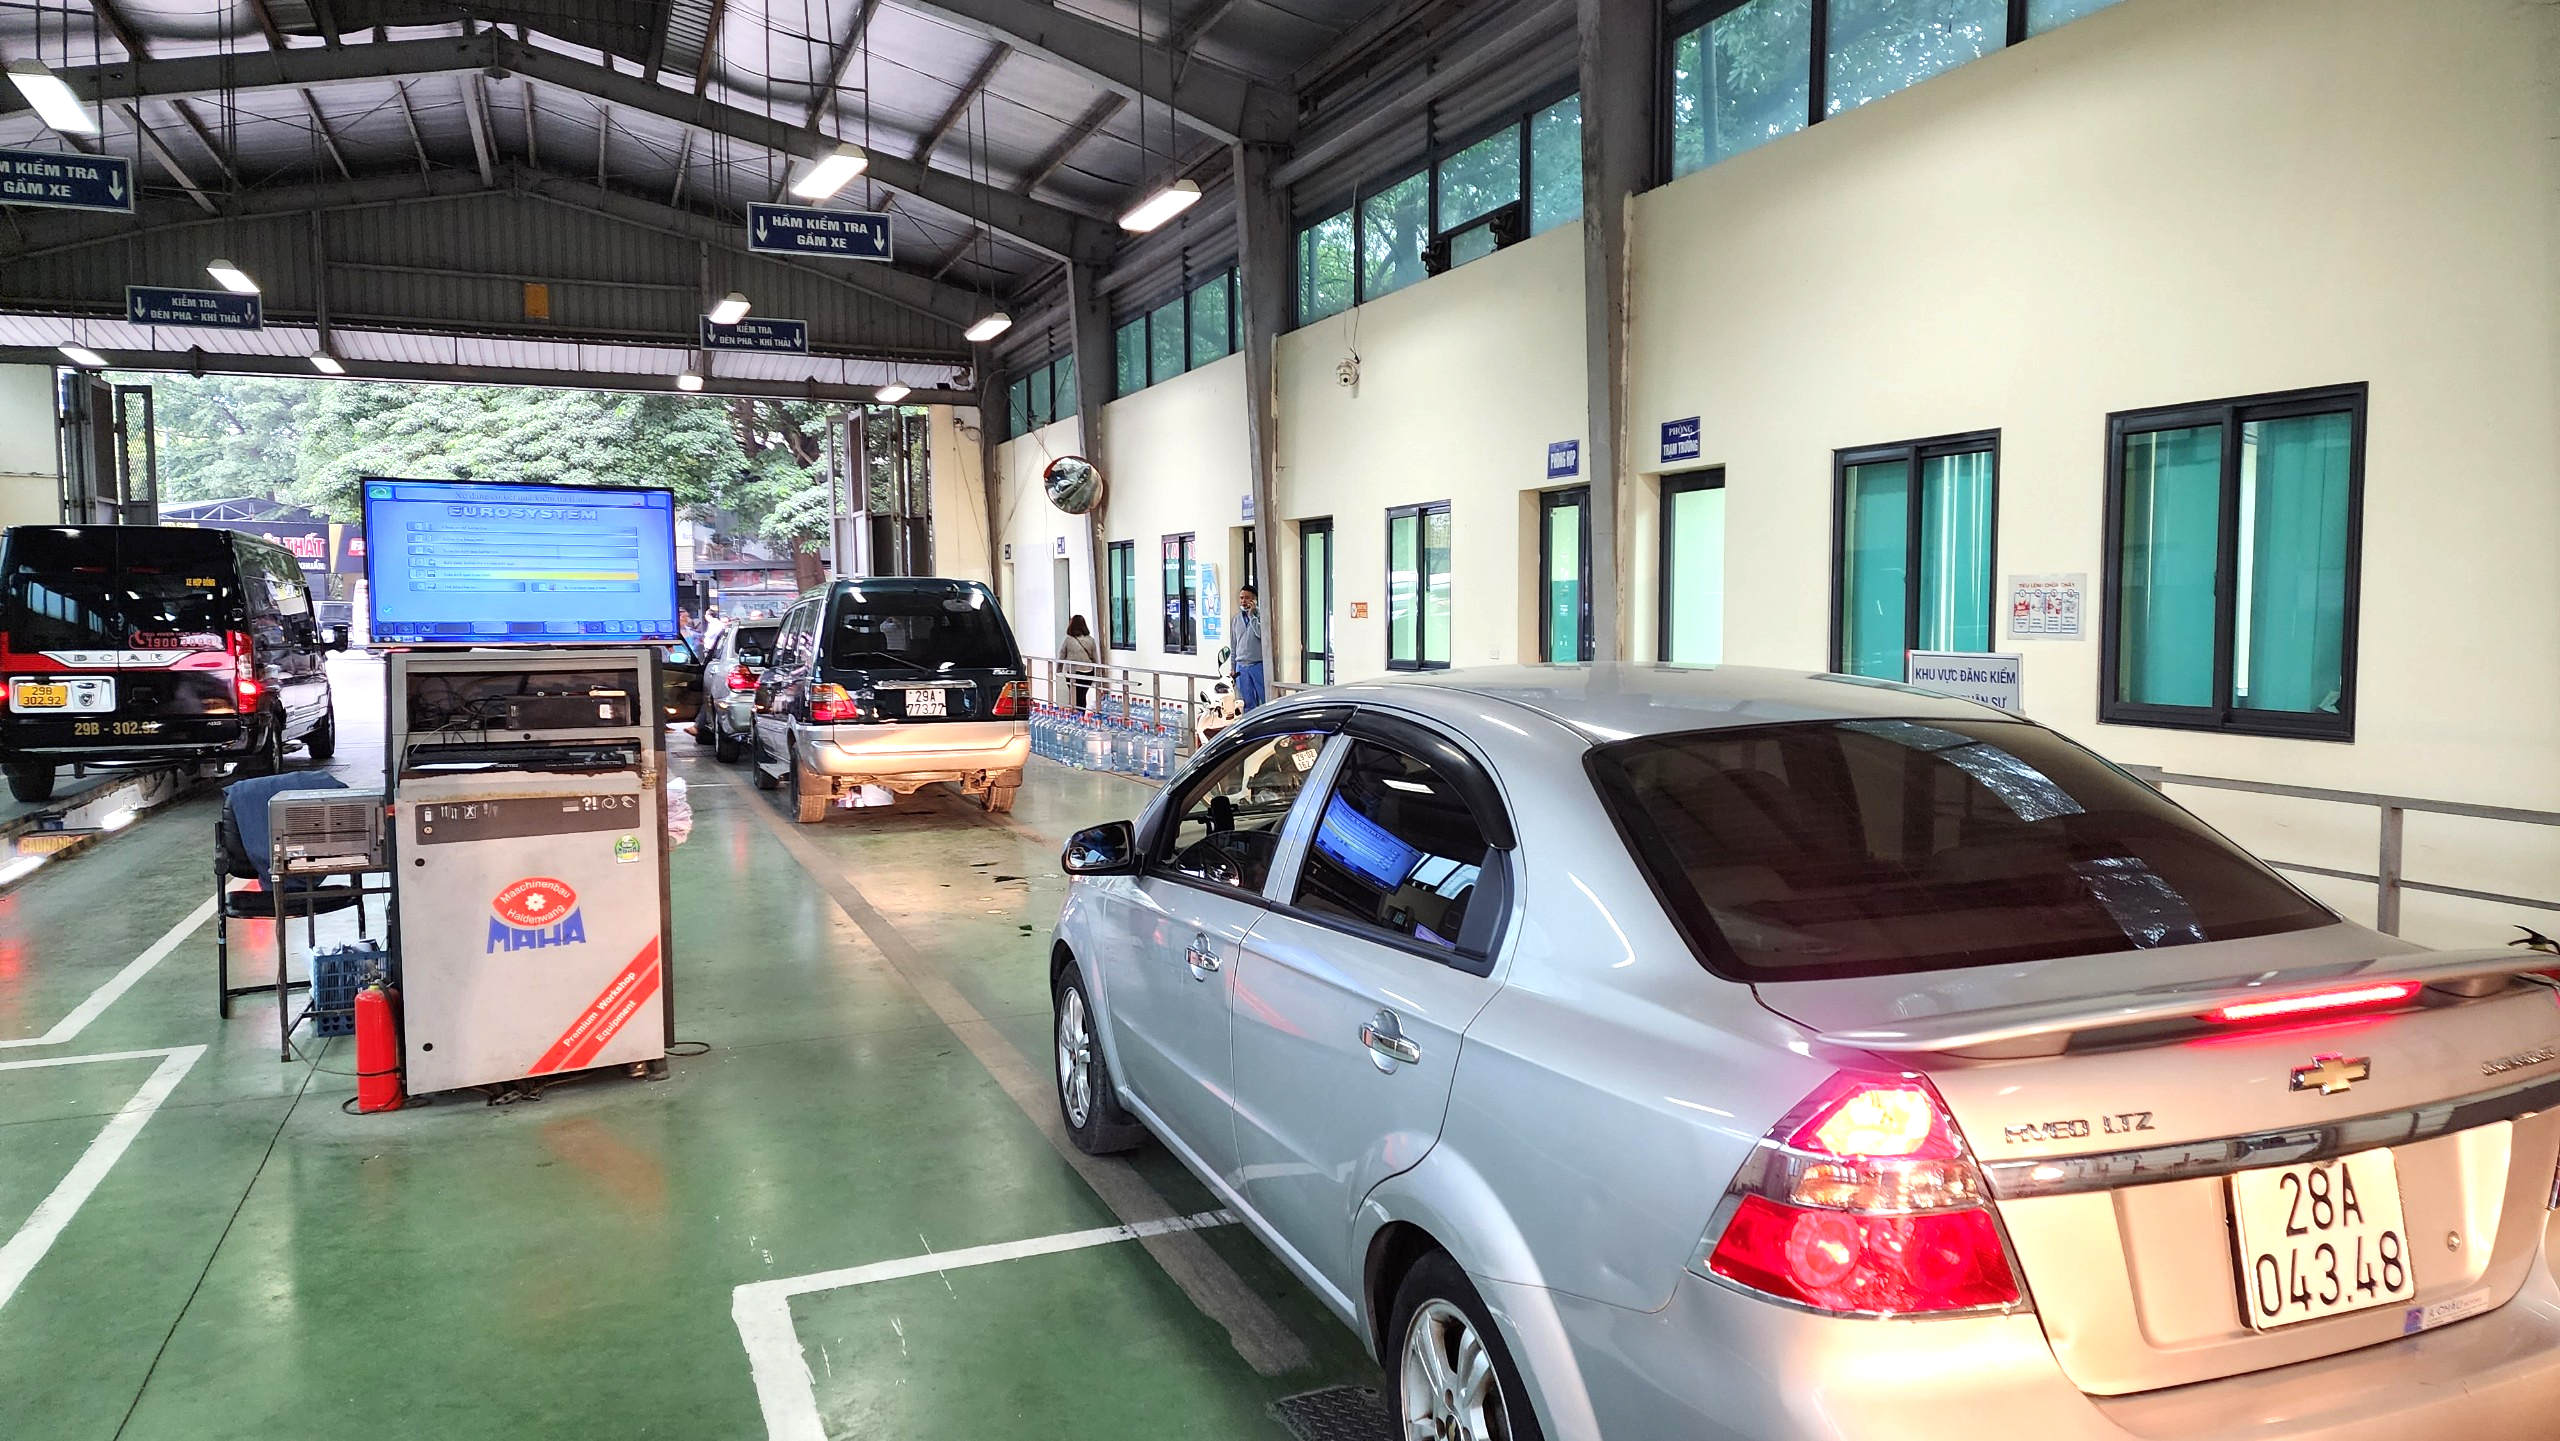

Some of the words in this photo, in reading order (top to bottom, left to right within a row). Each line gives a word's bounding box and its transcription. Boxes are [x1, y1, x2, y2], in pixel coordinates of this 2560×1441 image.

[16, 158, 60, 177] KIỂM
[65, 166, 99, 180] TRA
[3, 177, 43, 195] GẦM
[49, 185, 71, 197] XE
[772, 212, 803, 229] HẦM
[807, 215, 840, 232] KIỂM
[843, 222, 868, 234] TRA
[797, 232, 827, 247] GẦM
[830, 237, 848, 248] XE
[171, 294, 196, 308] KIỂM
[199, 299, 217, 309] TRA
[150, 307, 170, 320] ĐÈN
[173, 312, 192, 321] PHA
[201, 311, 217, 322] KHÍ
[217, 312, 241, 323] THẢI
[736, 322, 756, 334] KIỂM
[758, 325, 773, 335] TRA
[737, 337, 753, 345] PHA
[760, 337, 773, 347] KHÍ
[1668, 424, 1693, 437] PHÒNG
[1663, 443, 1677, 458] TRẠM
[447, 504, 598, 520] EUROSYSTEM
[283, 532, 325, 558] THẤT
[1915, 668, 1935, 681] KHU
[1937, 668, 1957, 684] VỰC
[1960, 667, 1987, 683] ĐĂNG
[1990, 667, 2016, 684] KIỂM
[32, 686, 53, 696] 29B
[915, 691, 936, 702] 29A
[24, 696, 61, 705] 302.92
[907, 703, 944, 716] 773.77
[74, 722, 100, 735] 29B
[112, 721, 160, 735] 302.92
[499, 880, 571, 904] Maschinenbau
[486, 906, 587, 954] MAHA
[563, 1012, 599, 1047] Premium
[596, 972, 636, 1010] Workshop
[595, 1000, 637, 1042] Equipment
[2004, 1119, 2091, 1144] AVEO
[2102, 1111, 2156, 1135] LTZ
[2278, 1163, 2365, 1238] 28A
[2255, 1229, 2406, 1318] 043.48
